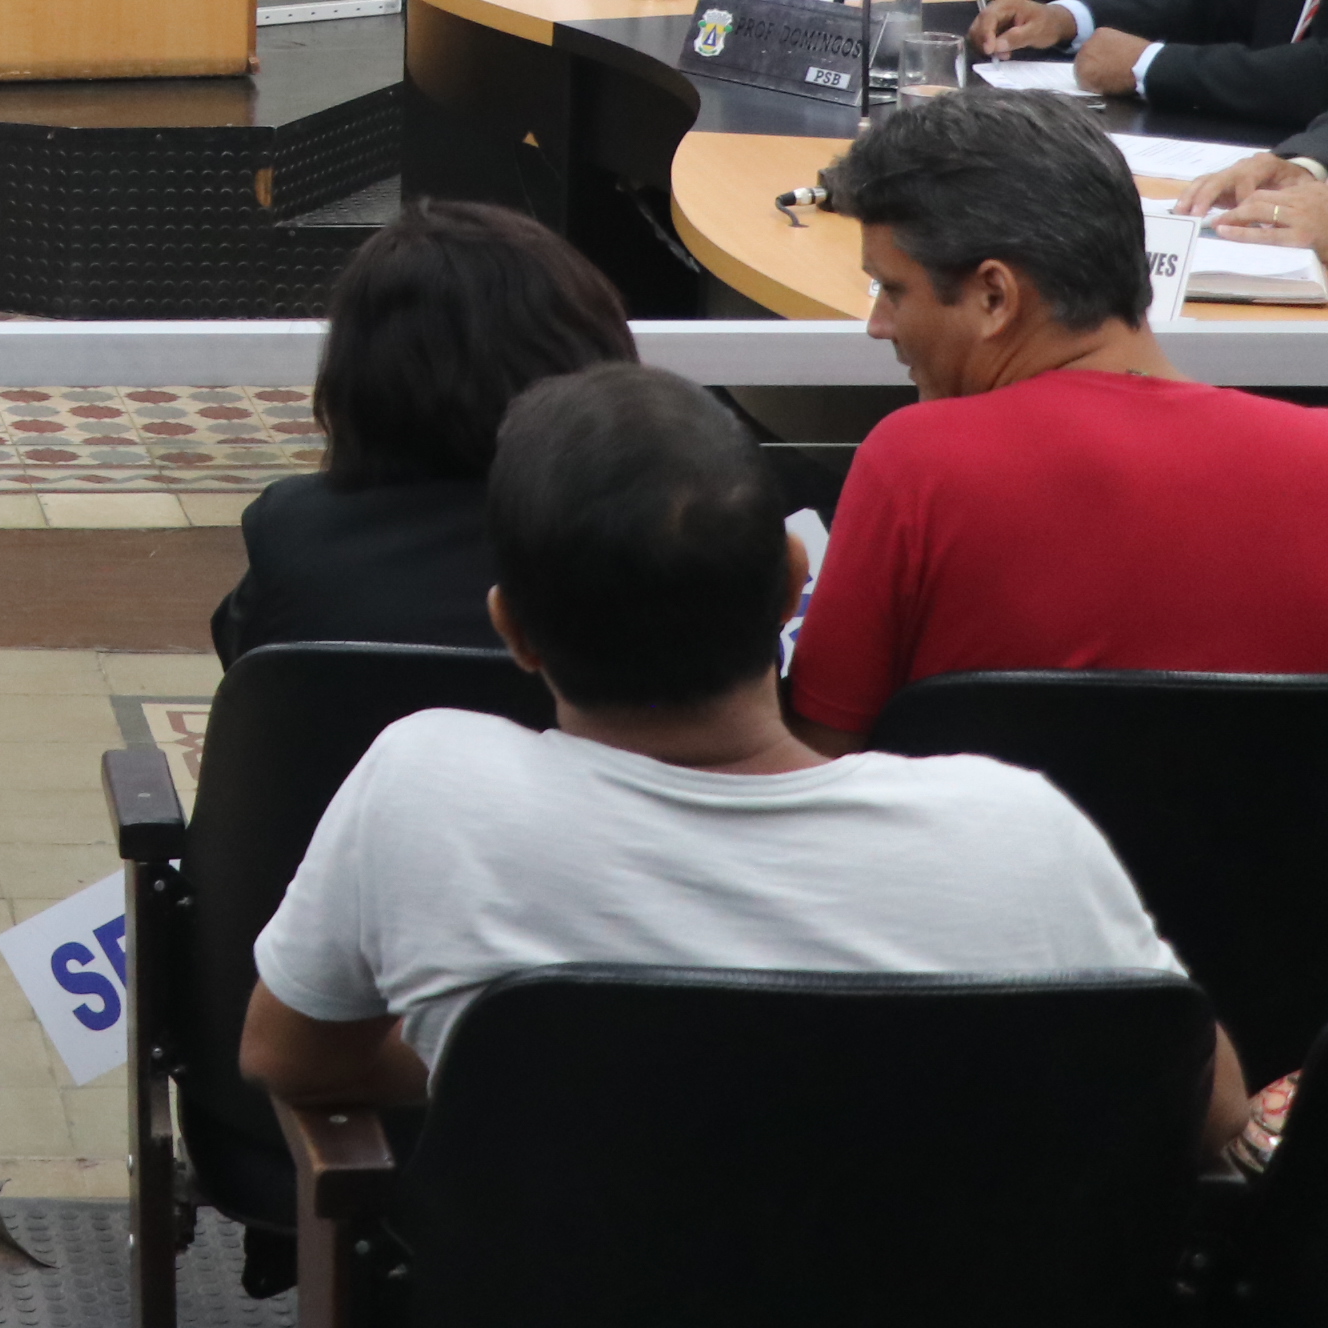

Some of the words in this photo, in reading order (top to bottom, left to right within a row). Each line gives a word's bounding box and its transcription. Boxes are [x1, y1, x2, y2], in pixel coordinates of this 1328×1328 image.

[735, 17, 772, 41] PROF
[778, 24, 863, 59] DOMINGOS
[812, 69, 842, 87] PSB
